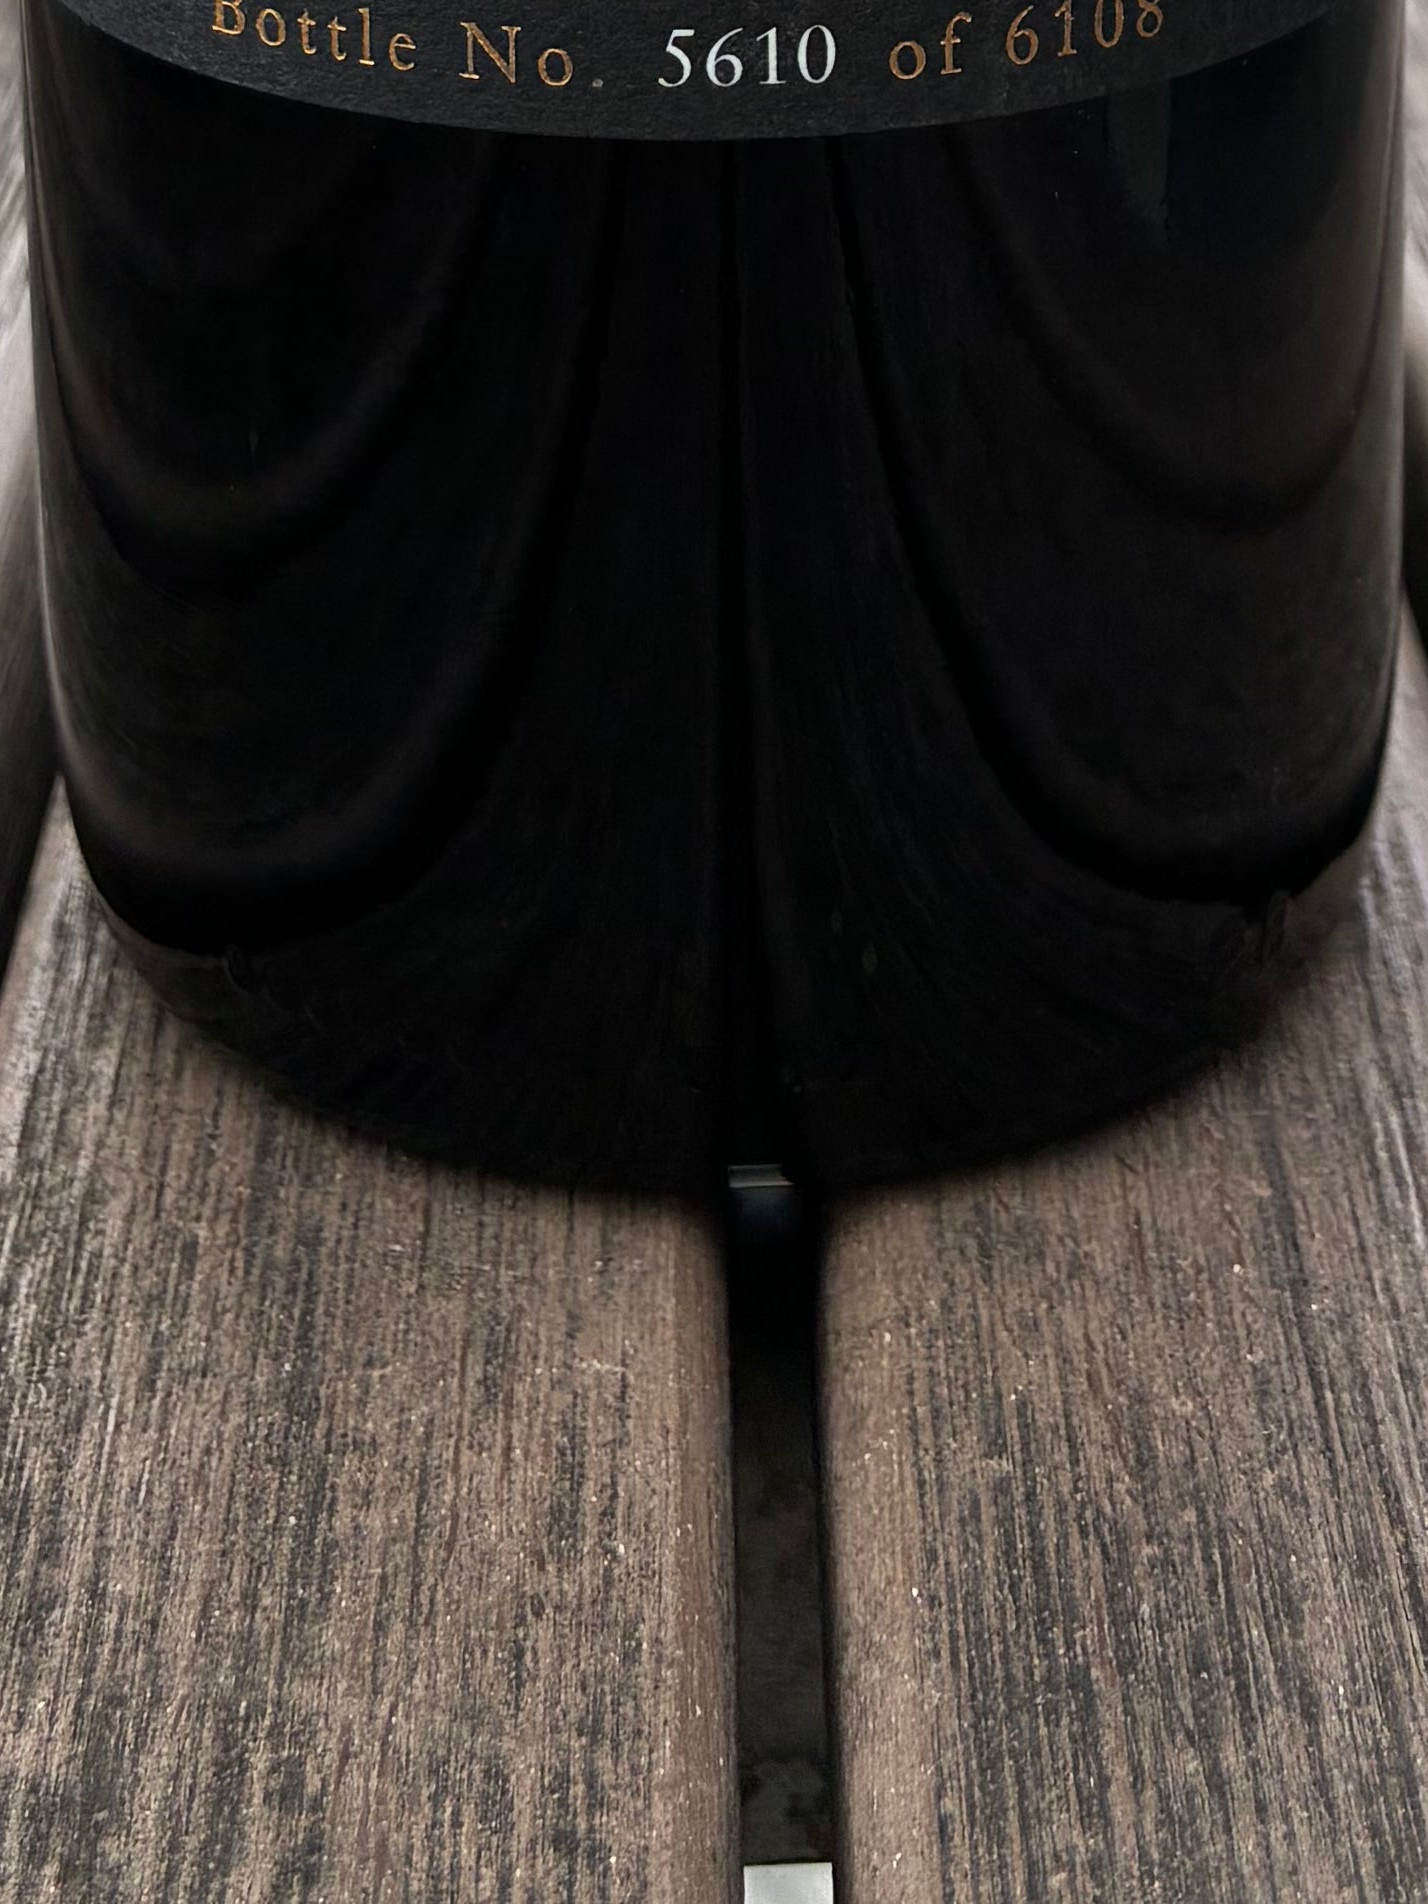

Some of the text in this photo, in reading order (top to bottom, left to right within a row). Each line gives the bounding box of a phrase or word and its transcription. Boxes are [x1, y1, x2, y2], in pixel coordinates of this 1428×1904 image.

[459, 20, 605, 88] No.
[656, 24, 838, 88] 5610
[887, 10, 973, 82] of
